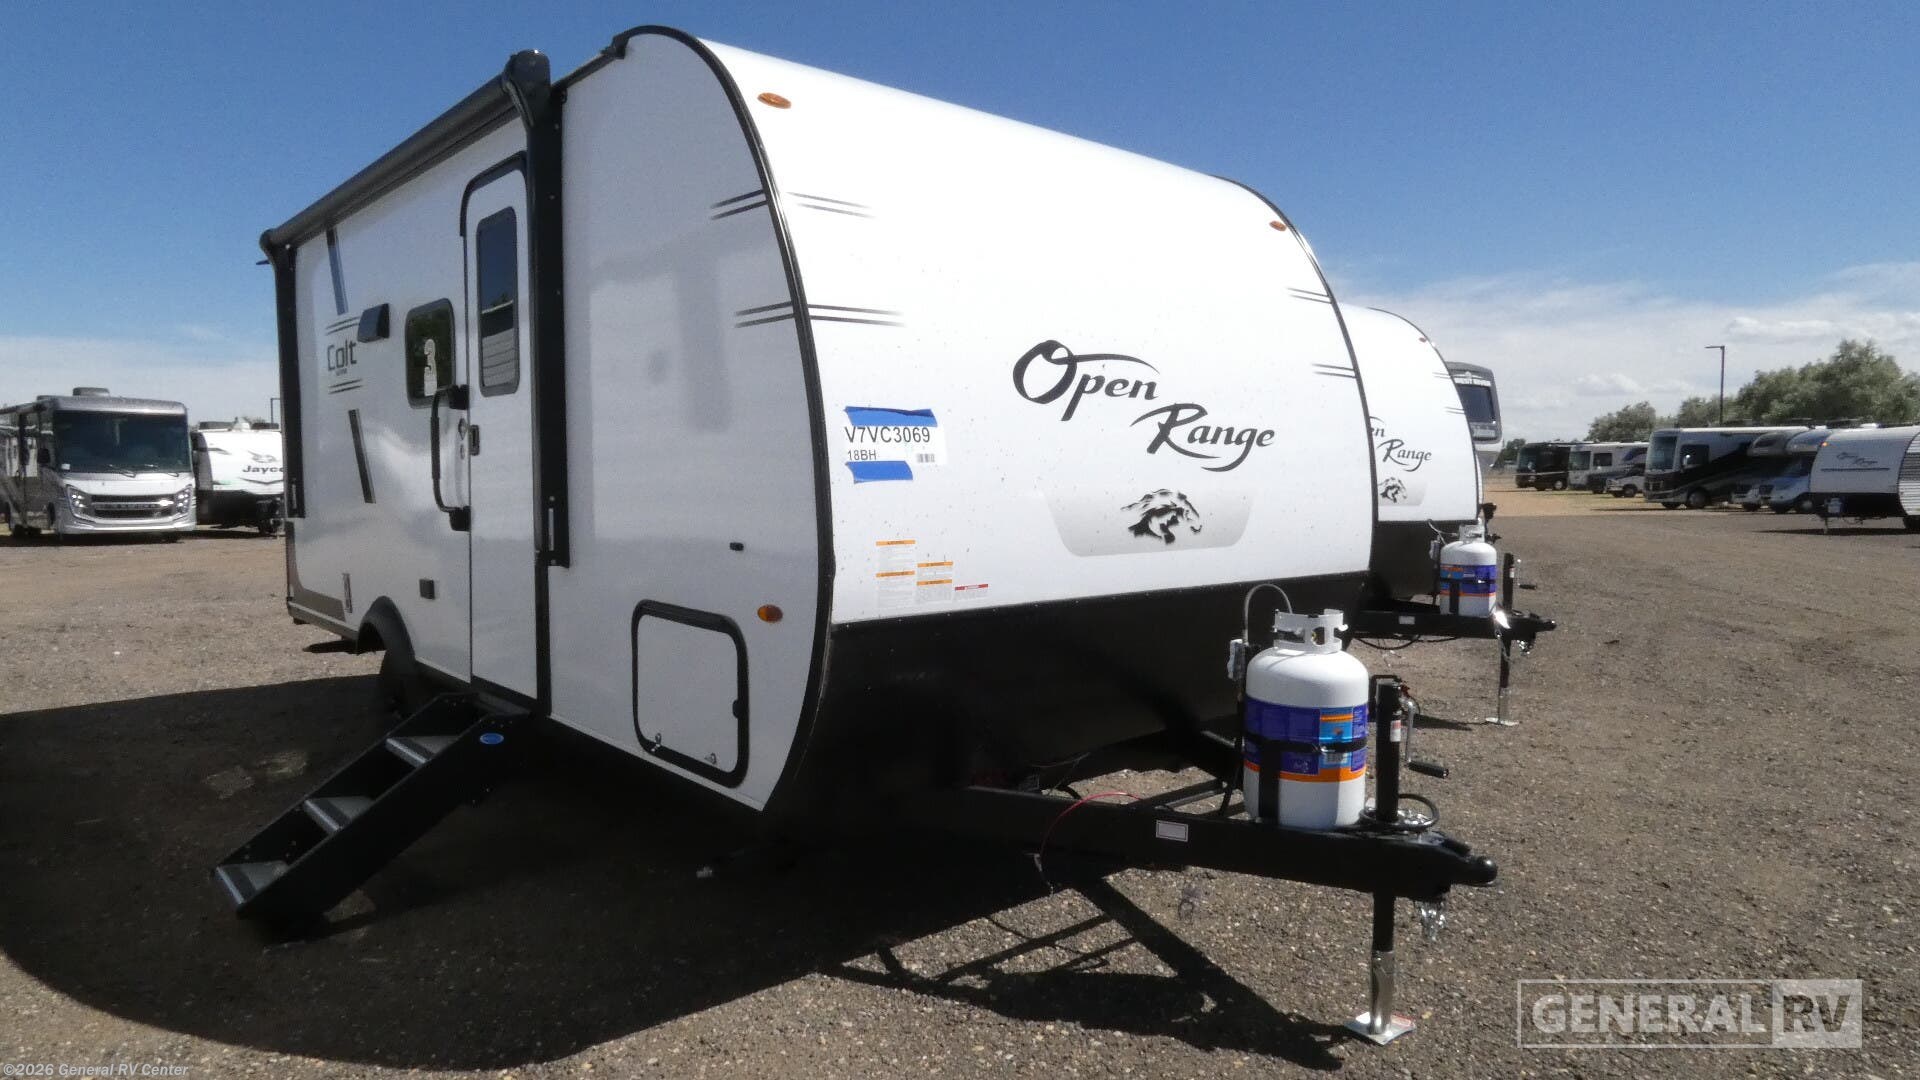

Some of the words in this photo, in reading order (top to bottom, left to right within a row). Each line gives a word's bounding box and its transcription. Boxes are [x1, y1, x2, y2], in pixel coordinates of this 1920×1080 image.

[327, 339, 357, 371] Colt
[1013, 340, 1160, 421] Open
[844, 426, 931, 443] V7VC3069
[1130, 403, 1275, 472] Range
[847, 449, 877, 461] 18BH
[1376, 439, 1432, 472] Range
